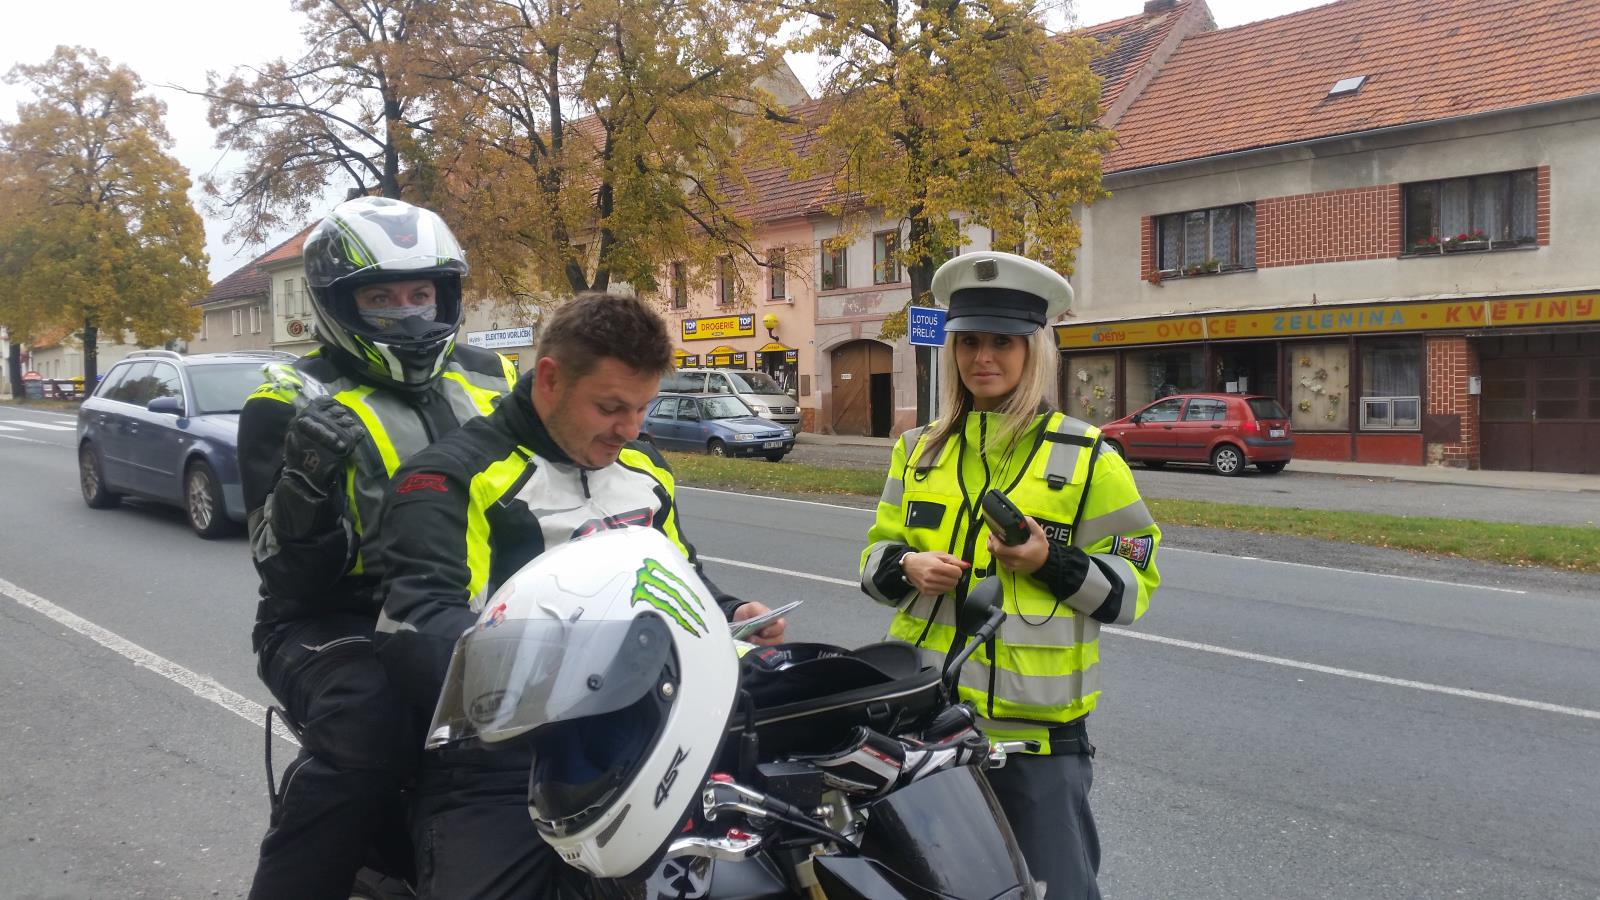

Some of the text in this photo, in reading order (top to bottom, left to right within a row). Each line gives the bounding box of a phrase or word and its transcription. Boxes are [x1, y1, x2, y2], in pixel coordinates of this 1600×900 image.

[912, 314, 938, 325] LOTOUŠ
[1157, 319, 1237, 338] OVOCE
[1272, 310, 1405, 331] ZELENINA
[686, 322, 696, 330] TOP
[701, 322, 734, 331] DROGERIE
[912, 325, 935, 338] PŘELÍC
[486, 332, 506, 340] ELEKTRO
[1041, 525, 1069, 541] CIE
[654, 745, 692, 810] 4SR
